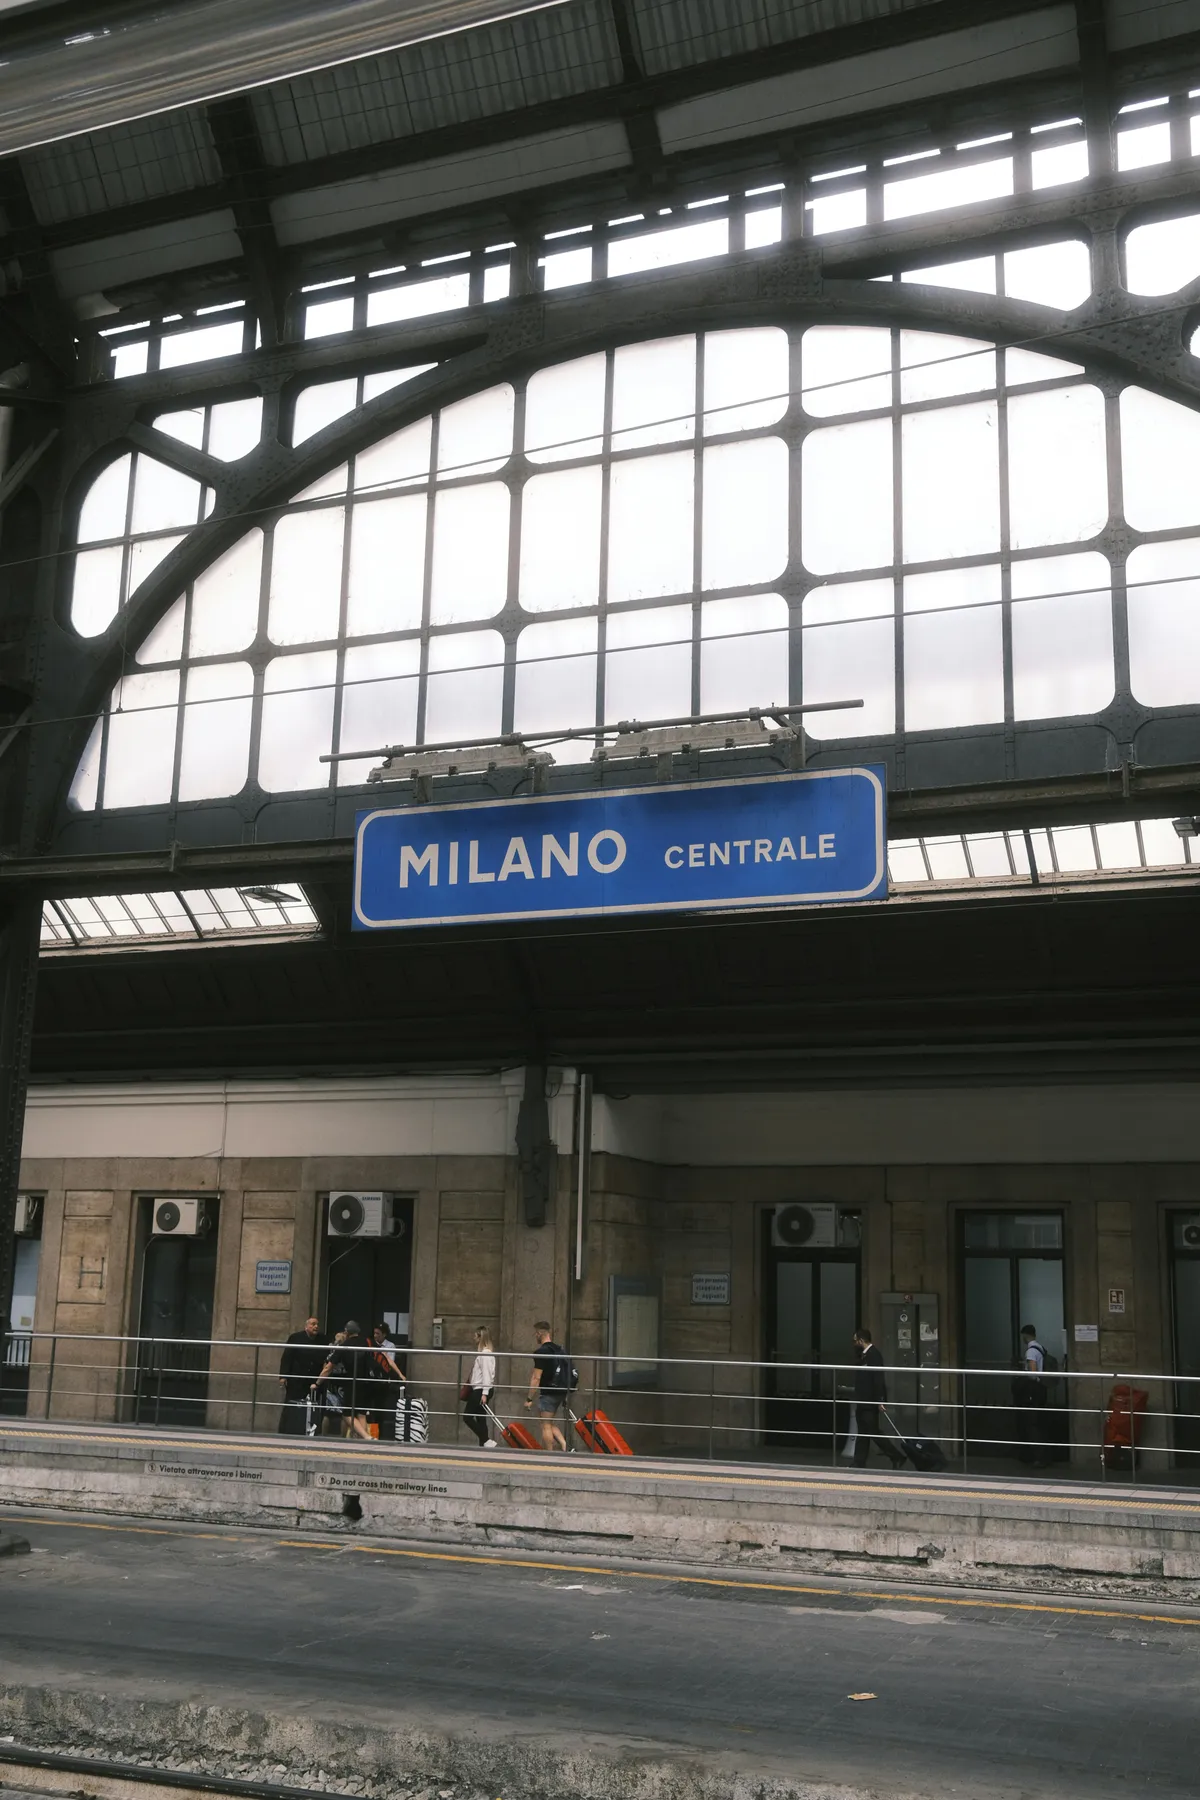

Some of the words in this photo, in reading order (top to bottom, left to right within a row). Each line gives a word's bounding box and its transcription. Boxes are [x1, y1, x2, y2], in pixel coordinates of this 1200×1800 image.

[399, 829, 627, 888] MILANO
[664, 833, 836, 869] CENTRALE
[160, 1465, 186, 1474] Vietato
[188, 1467, 234, 1478] attraversare
[240, 1471, 262, 1479] binari
[330, 1477, 341, 1485] Do
[343, 1478, 356, 1487] not
[358, 1480, 378, 1488] cross
[380, 1480, 393, 1490] the
[395, 1482, 427, 1493] railway
[428, 1484, 447, 1493] lines
